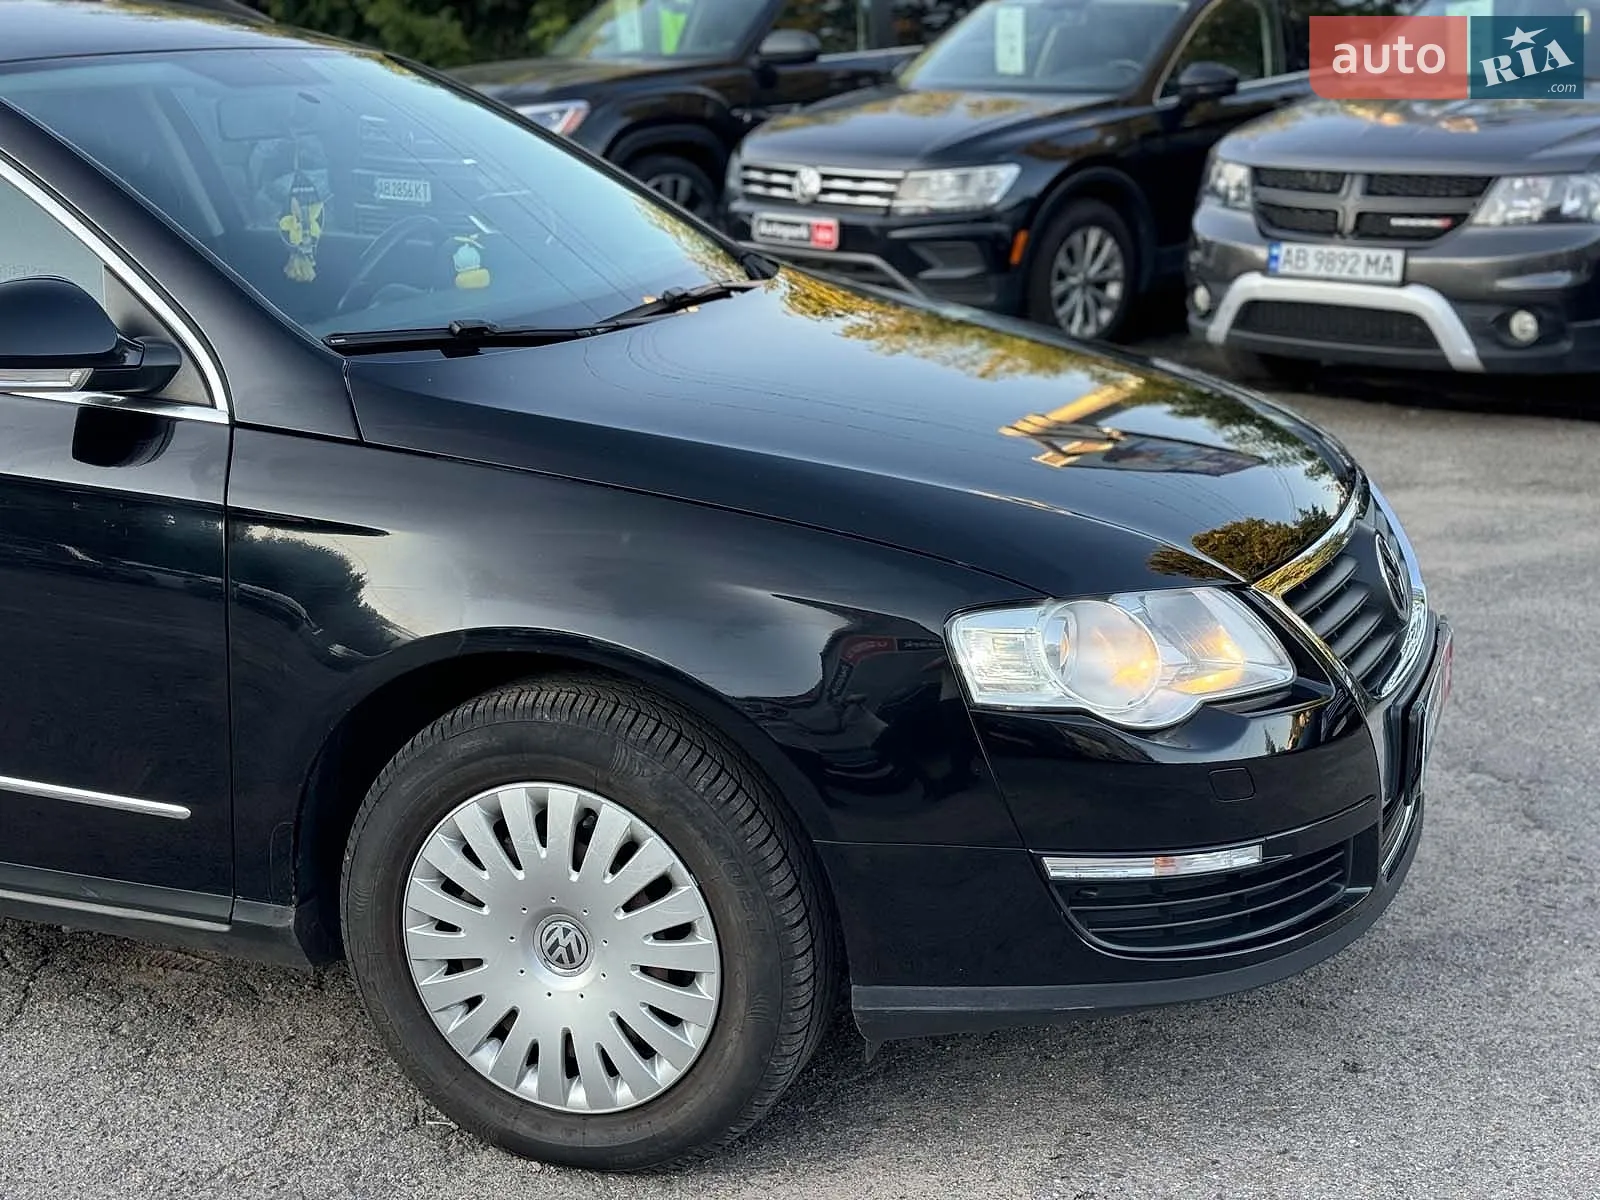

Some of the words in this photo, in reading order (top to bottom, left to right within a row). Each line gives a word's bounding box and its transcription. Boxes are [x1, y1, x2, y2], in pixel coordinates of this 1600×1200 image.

[1282, 247, 1309, 271] AB
[1314, 249, 1361, 275] 9892
[1364, 254, 1394, 277] MA
